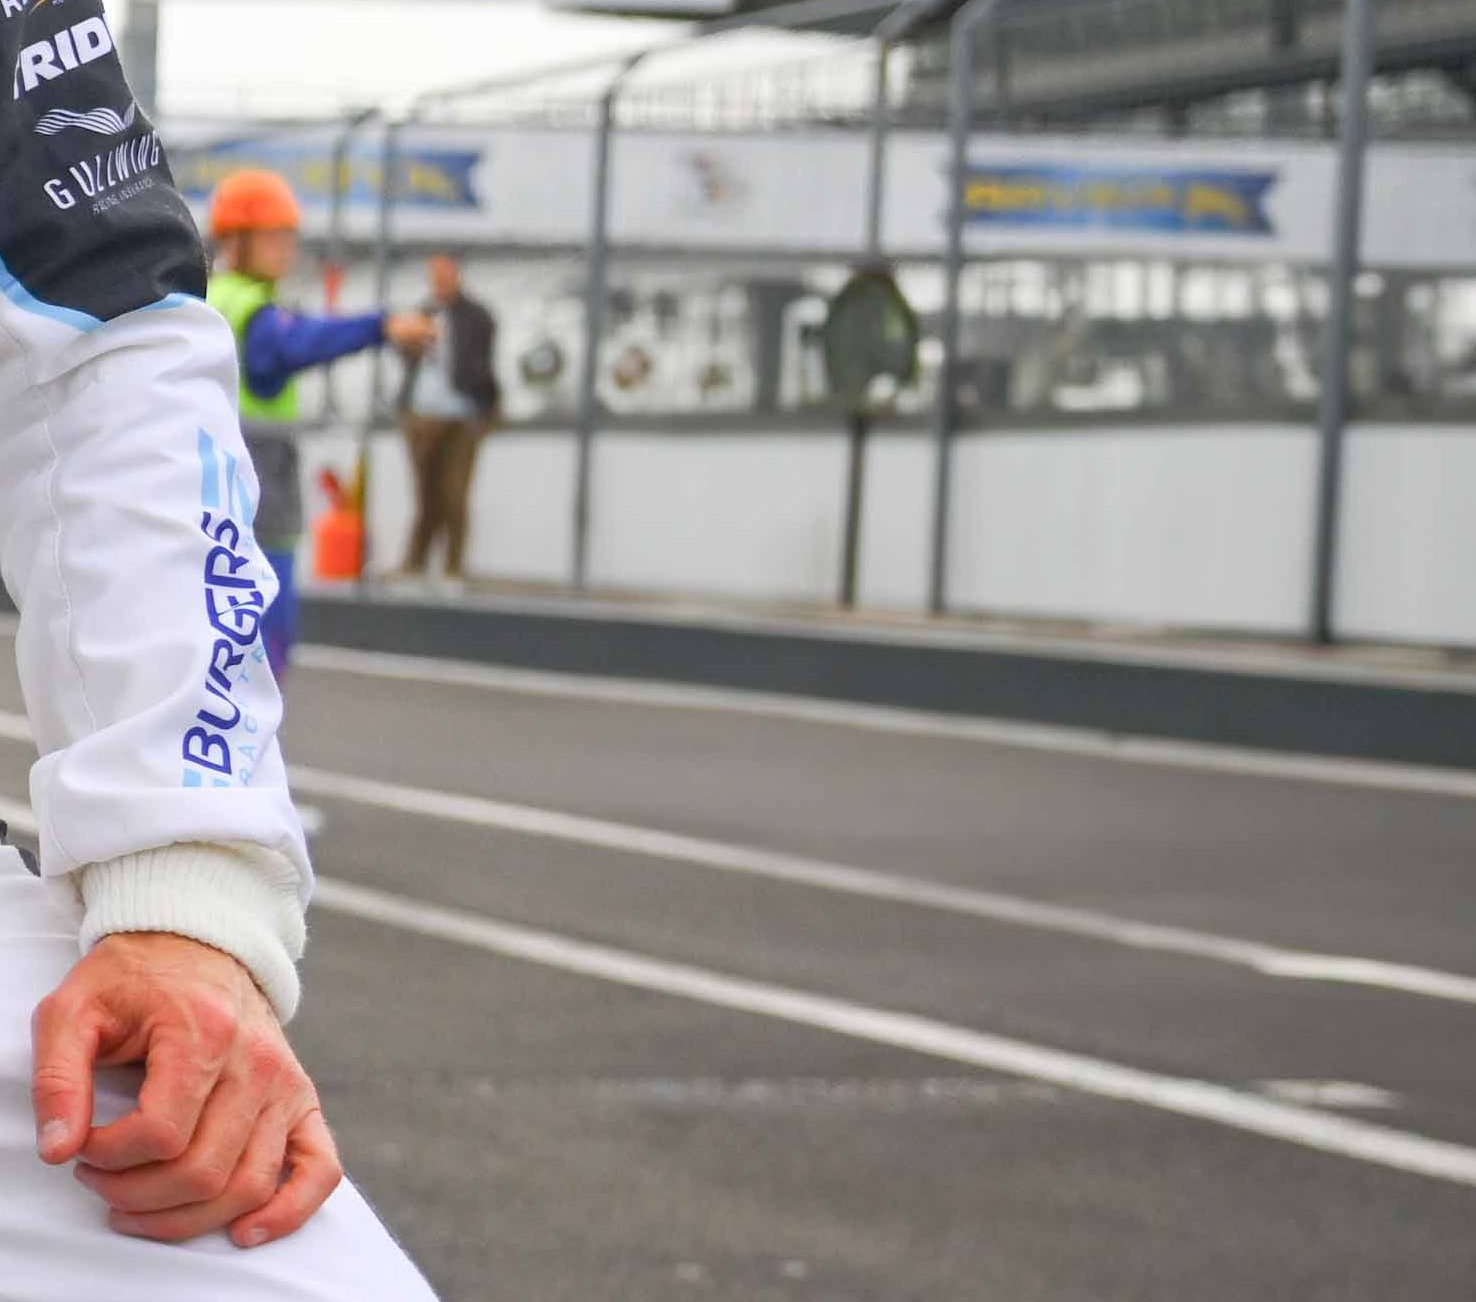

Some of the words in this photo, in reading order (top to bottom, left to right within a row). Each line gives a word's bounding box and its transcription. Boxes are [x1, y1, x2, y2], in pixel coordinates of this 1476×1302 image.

[13, 12, 113, 99] RID
[42, 129, 160, 210] GULLWING
[182, 511, 264, 775] BURGERS
